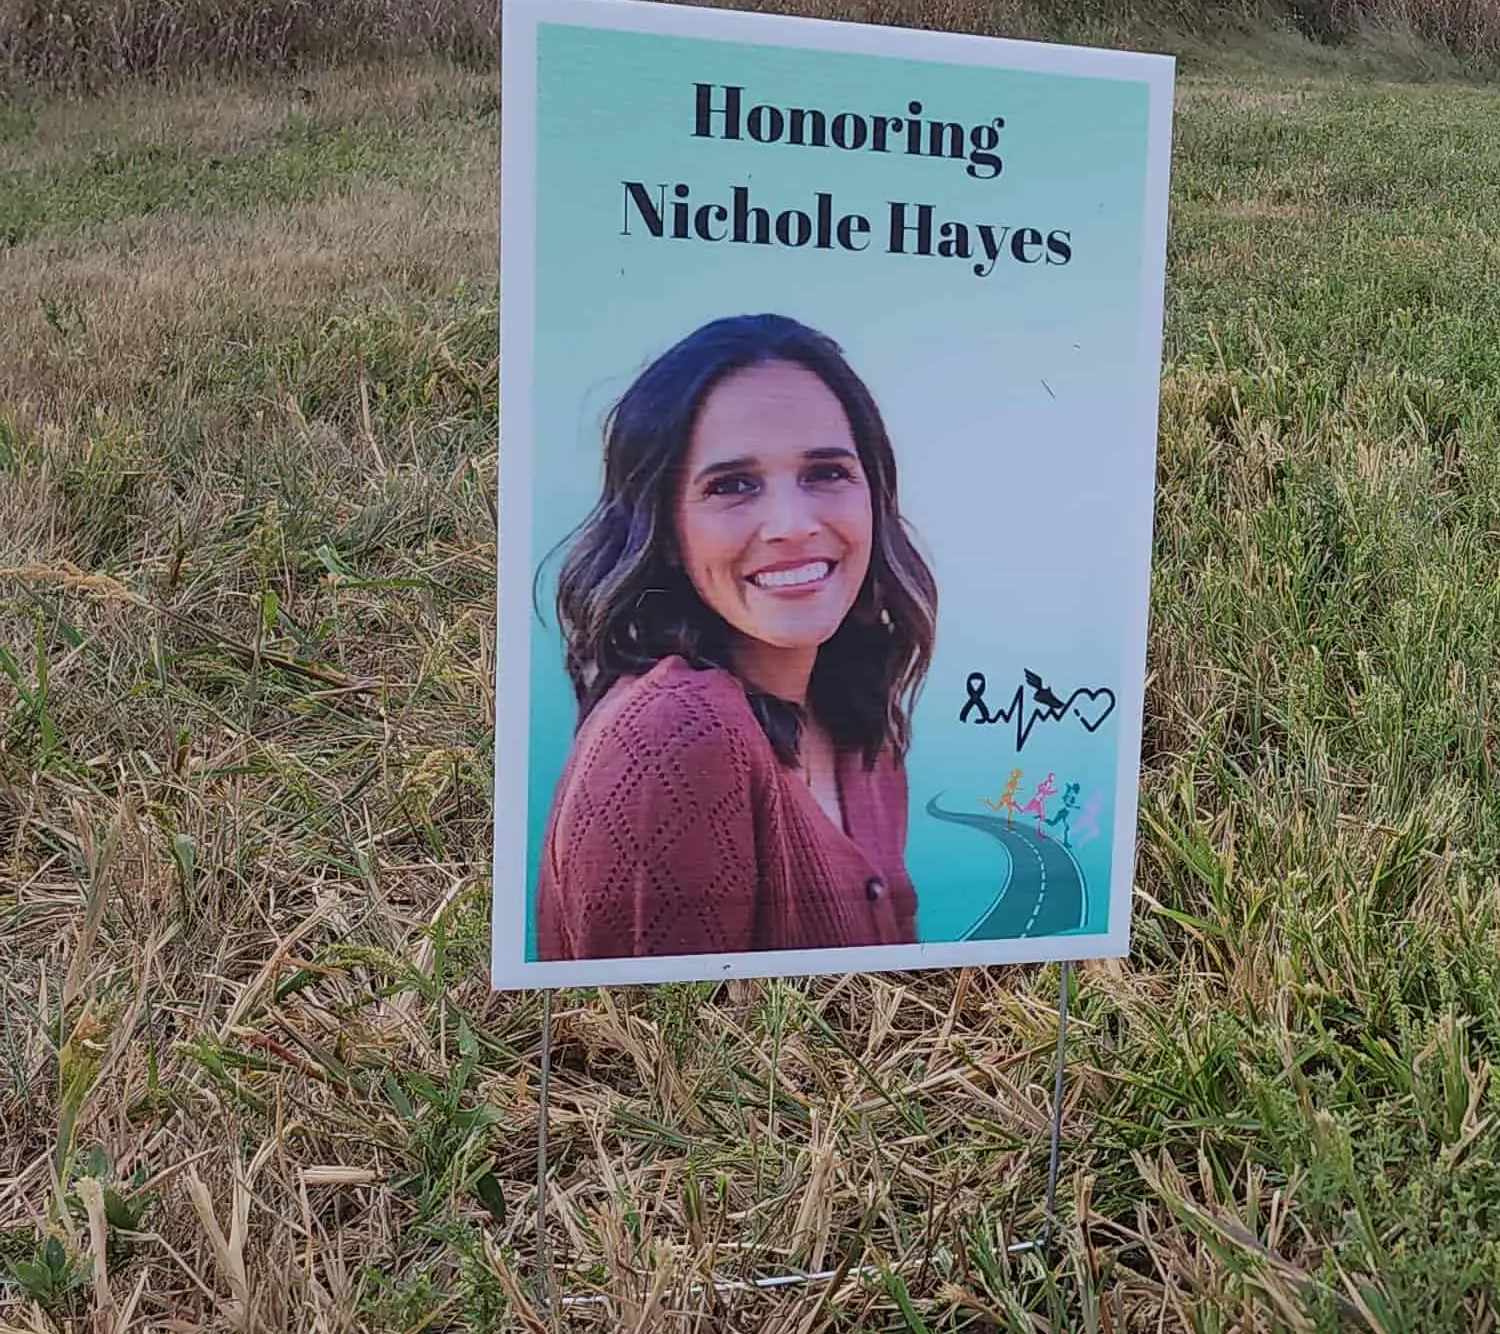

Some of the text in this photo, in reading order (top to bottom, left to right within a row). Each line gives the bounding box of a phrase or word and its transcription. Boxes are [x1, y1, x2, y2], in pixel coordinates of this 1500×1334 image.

[690, 82, 1005, 179] Honoring
[619, 181, 1072, 277] Nichole Hayes
